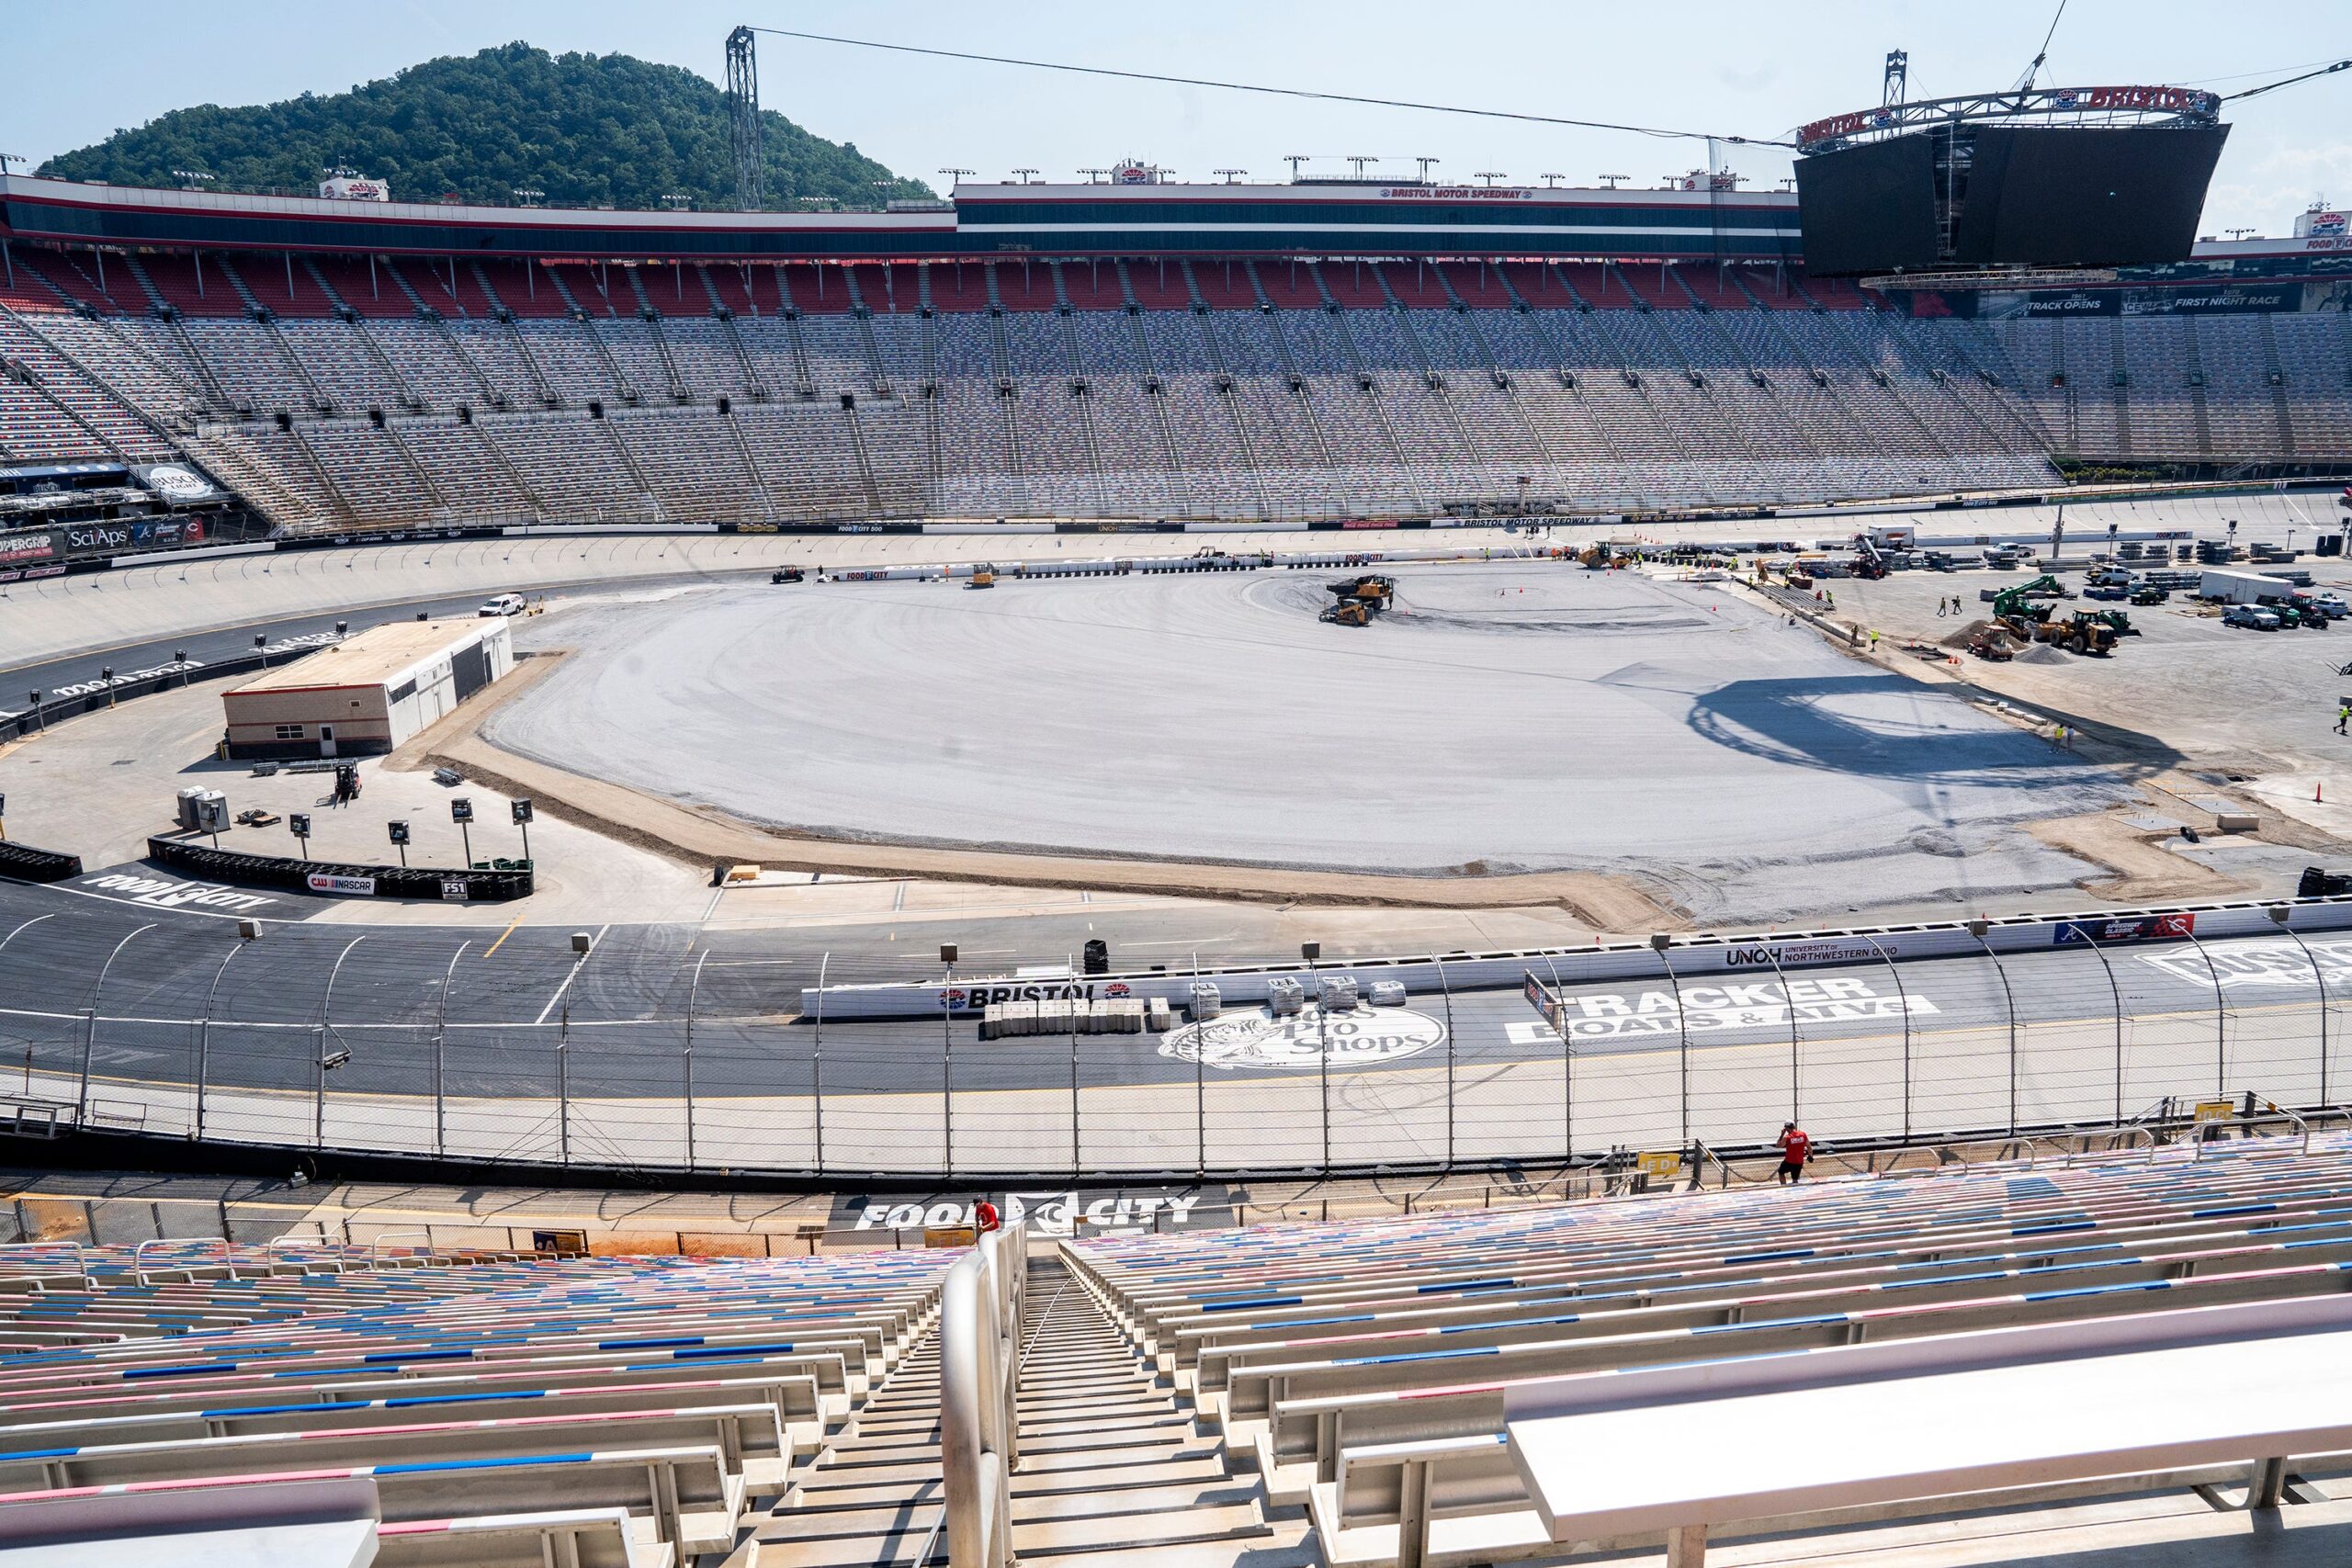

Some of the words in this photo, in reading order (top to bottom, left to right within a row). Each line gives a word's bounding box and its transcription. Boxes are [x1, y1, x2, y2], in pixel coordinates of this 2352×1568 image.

[2087, 86, 2190, 108] BRISTOL
[1391, 188, 1431, 198] BRISTOL
[1434, 188, 1469, 198] MOTOR
[1471, 189, 1521, 199] SPEEDWAY
[2306, 240, 2333, 250] FOOD
[2028, 301, 2063, 310] TRACK
[2064, 300, 2101, 310] OPENS
[2175, 298, 2211, 308] FIRST
[2209, 297, 2250, 306] NIGHT
[2250, 296, 2280, 305] RACE
[156, 474, 203, 486] BUSCH
[171, 482, 198, 491] LIGHT
[1464, 519, 1503, 527] BRISTOL
[1505, 518, 1540, 526] MOTOR
[1542, 516, 1591, 525] SPEEDWAY
[81, 874, 173, 894] FOOD
[337, 880, 371, 891] NASCAR
[444, 883, 465, 893] FS1
[1785, 944, 1830, 953] UNIVERSITY
[1785, 948, 1870, 963] NORTHWESTERN
[1872, 946, 1898, 956] OHIO
[1726, 947, 1781, 965] UNOH
[967, 985, 1094, 1009] BRISTOL
[1529, 977, 1877, 1018] RACKER
[1740, 1011, 1766, 1024] &
[1782, 1001, 1914, 1021] ATVS
[1286, 1021, 1360, 1040] Pro
[1290, 1033, 1429, 1055] Shops
[1084, 1196, 1201, 1224] CITY
